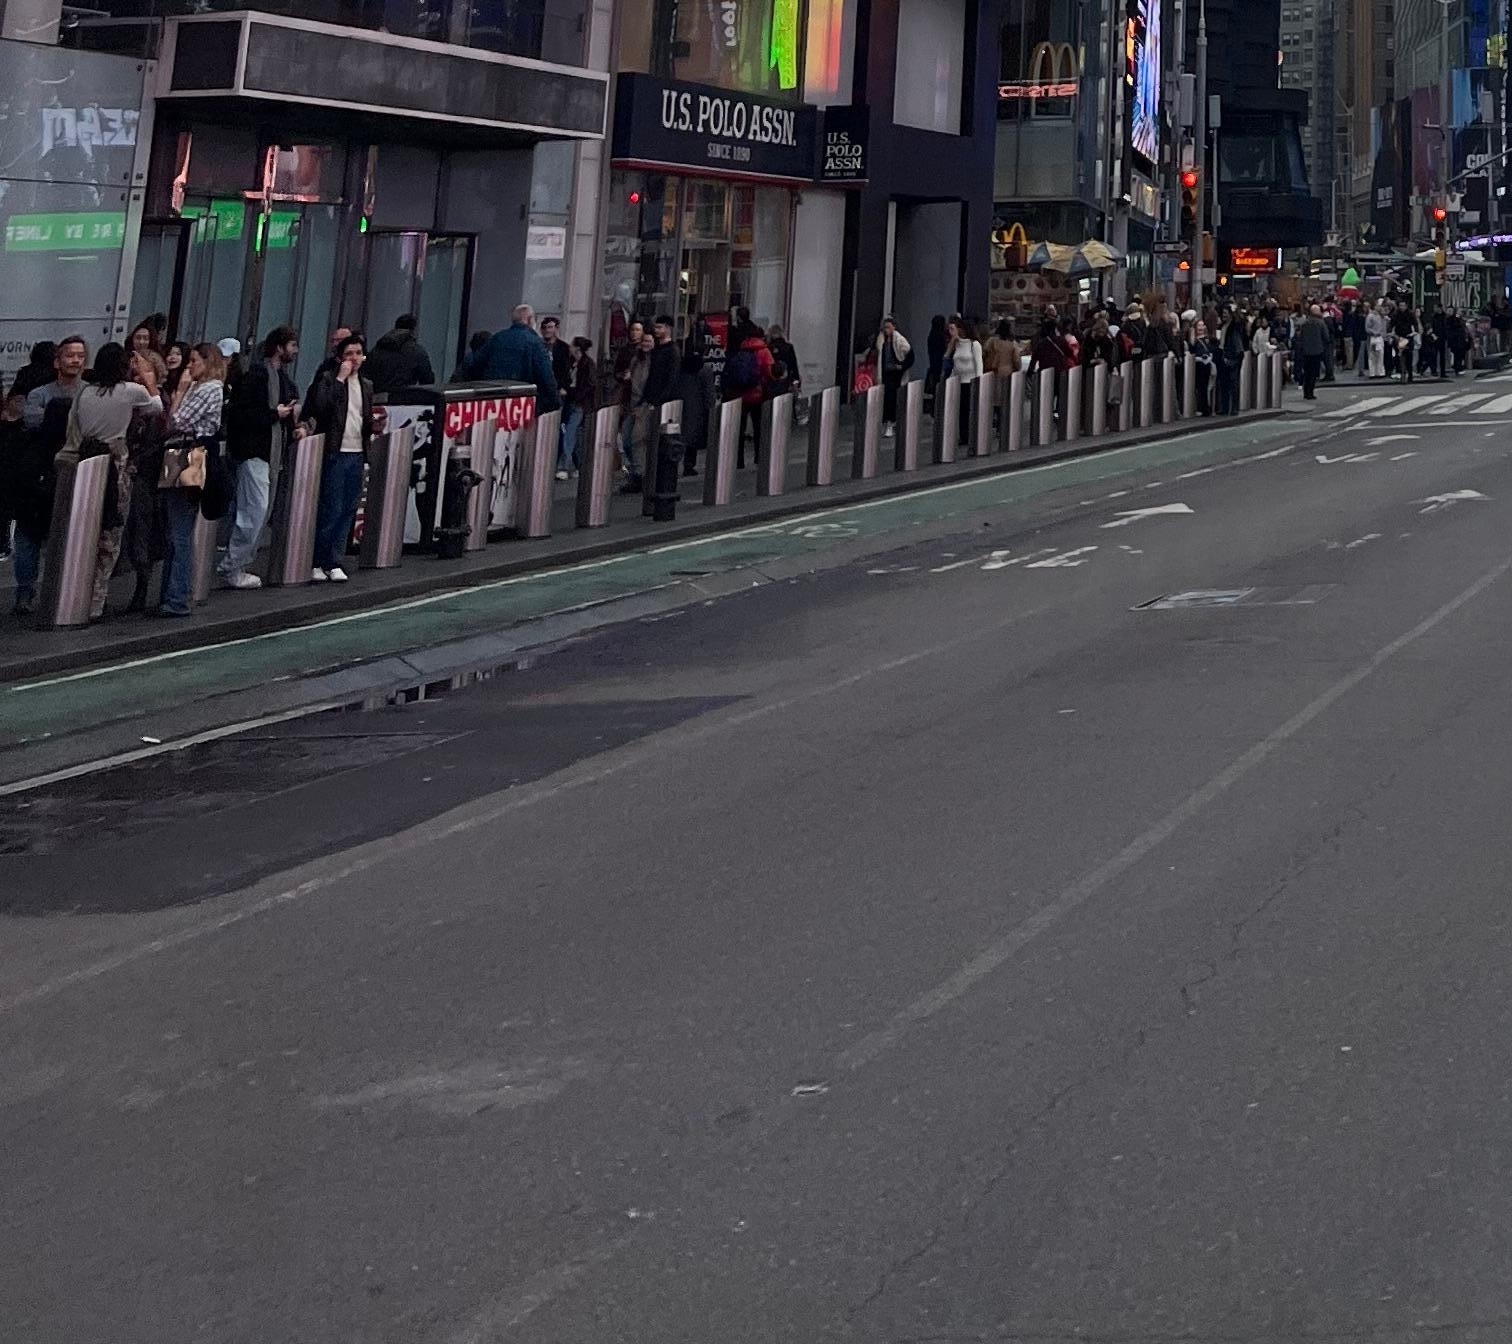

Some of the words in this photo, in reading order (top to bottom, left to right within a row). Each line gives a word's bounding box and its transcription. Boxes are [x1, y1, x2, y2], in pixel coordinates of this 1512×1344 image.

[662, 88, 693, 131] U.S.
[697, 94, 747, 139] POLO
[747, 105, 797, 147] ASSN.
[827, 132, 851, 144] U.S.
[707, 142, 731, 160] SINCE
[825, 144, 863, 158] POLO
[824, 157, 864, 170] ASSN.
[0, 341, 32, 354] VORN
[446, 396, 537, 438] CHICAGO
